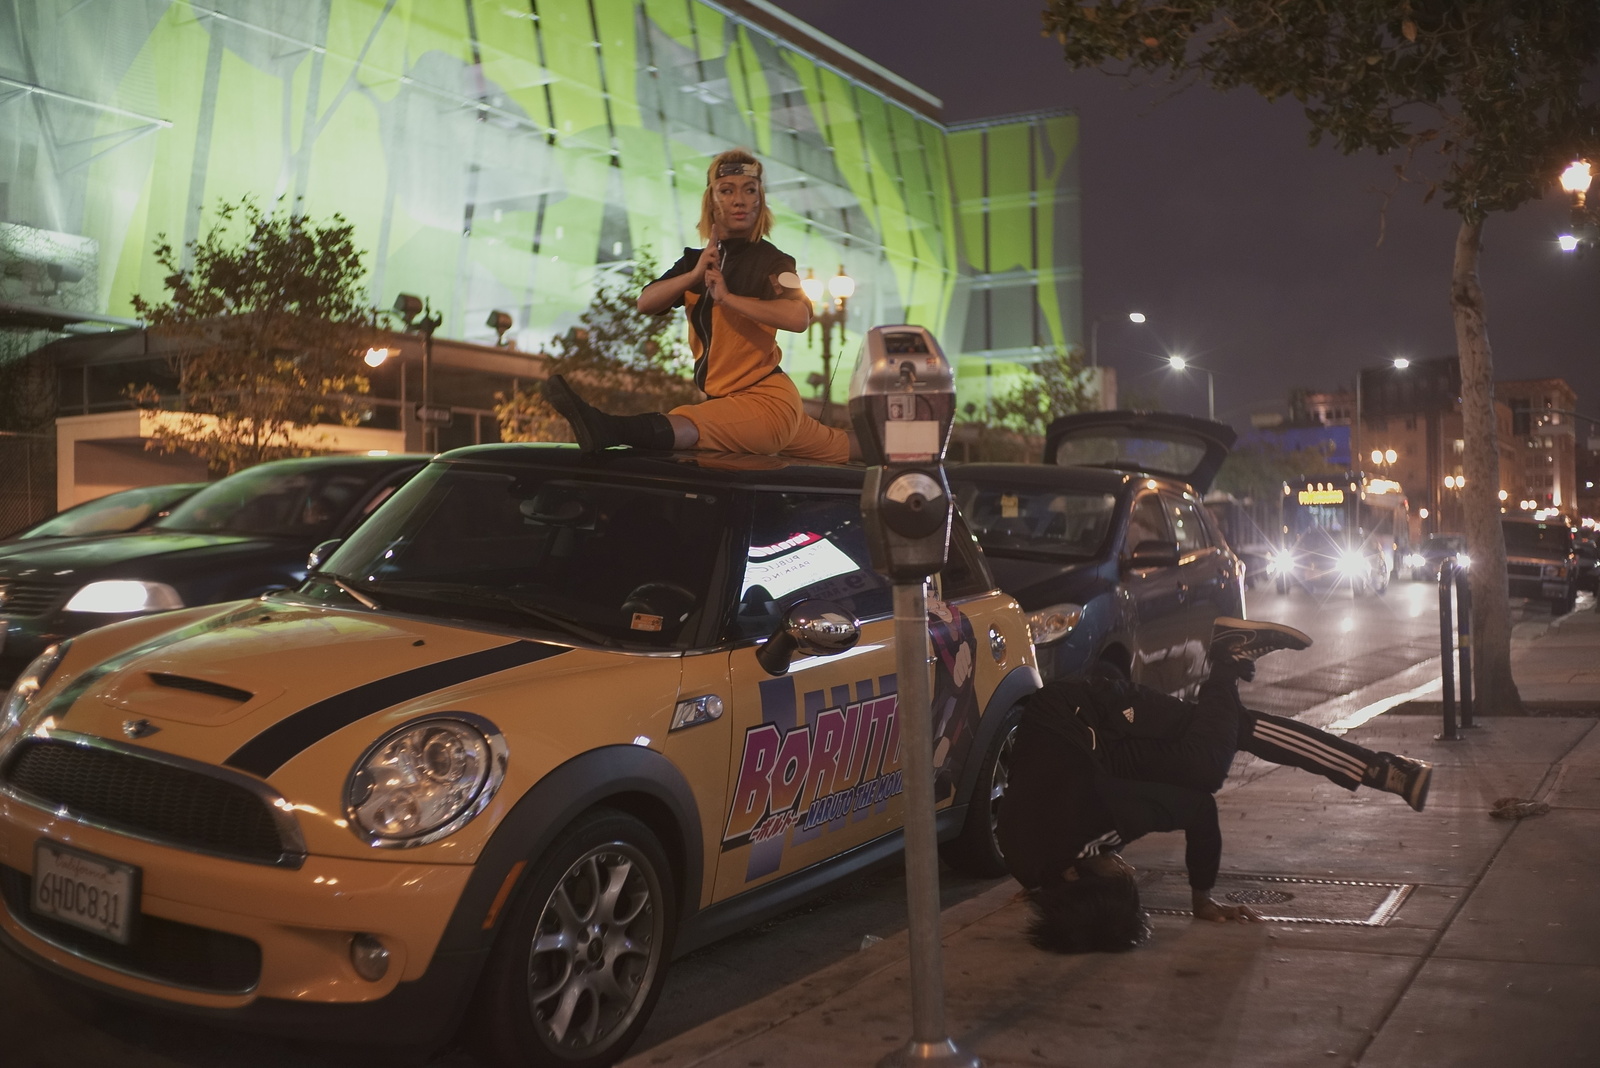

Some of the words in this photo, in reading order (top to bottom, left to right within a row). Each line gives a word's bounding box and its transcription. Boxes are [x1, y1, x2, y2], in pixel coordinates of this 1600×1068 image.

[804, 786, 855, 832] NARUTO
[852, 777, 878, 812] THE
[874, 769, 903, 804] MOVI
[55, 854, 109, 881] California
[39, 871, 120, 929] 6HDC831
